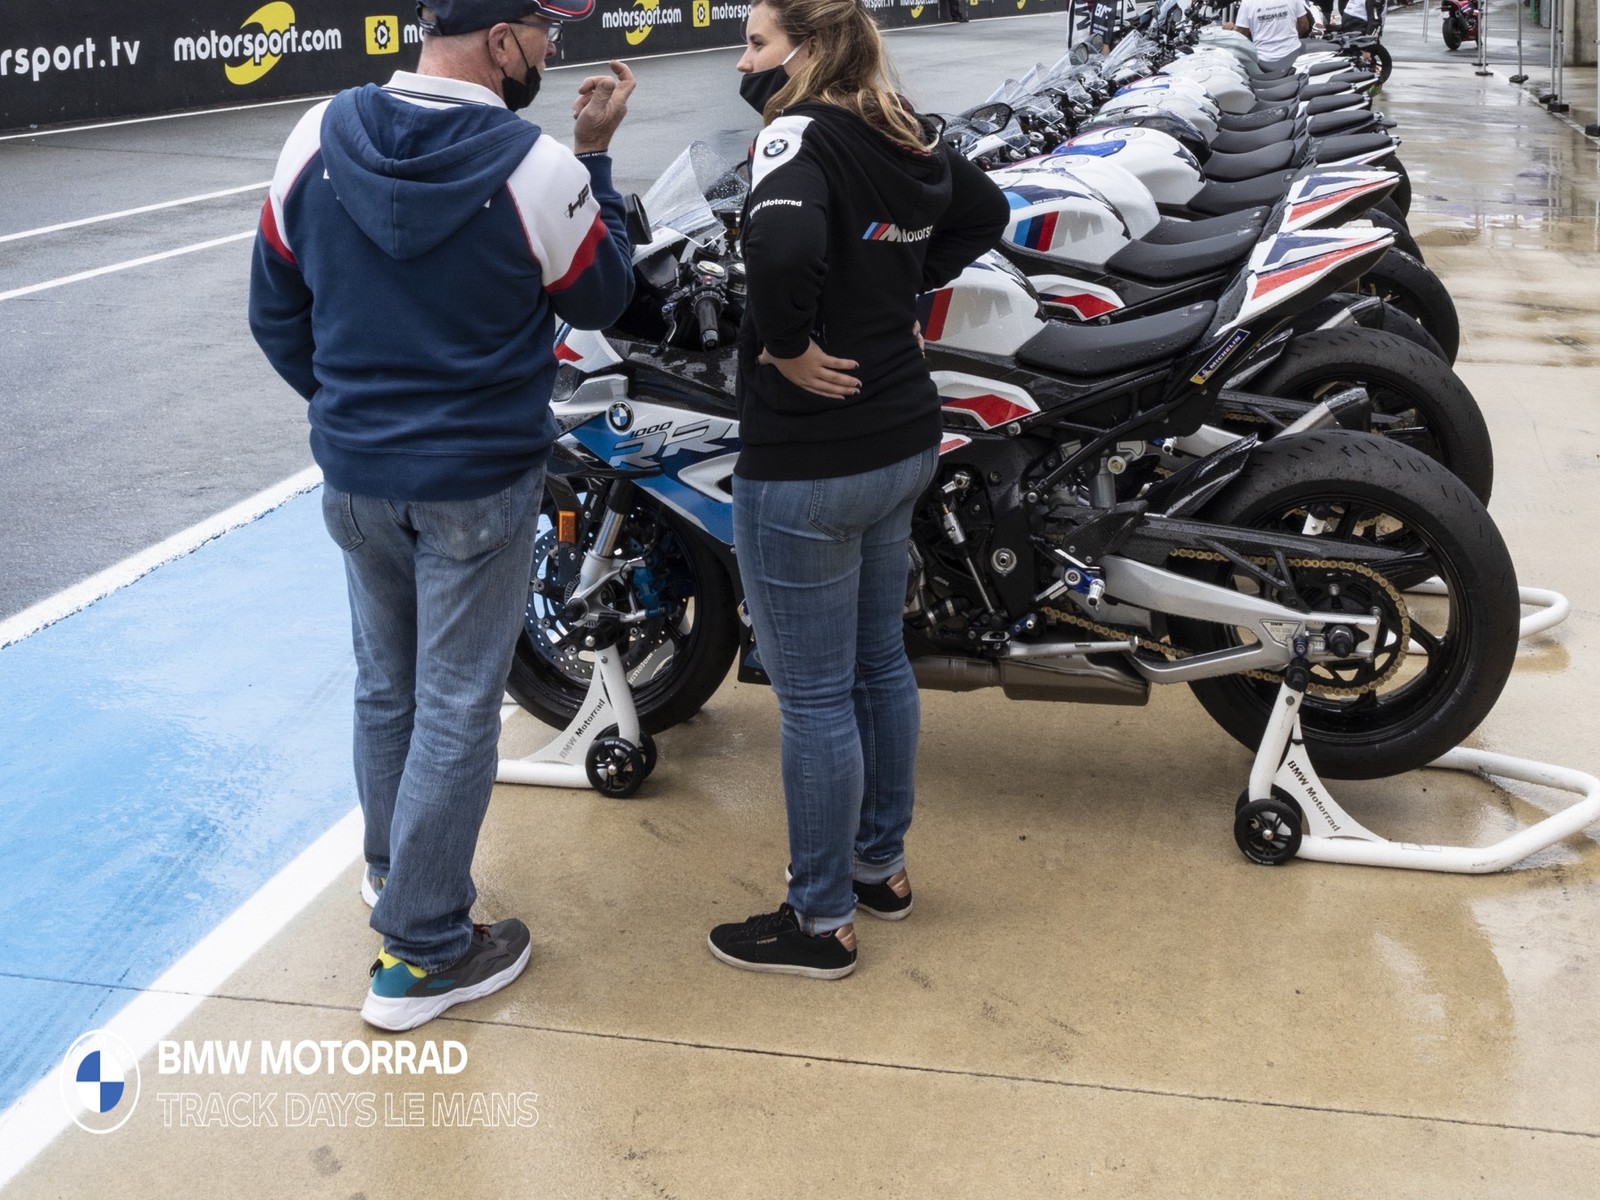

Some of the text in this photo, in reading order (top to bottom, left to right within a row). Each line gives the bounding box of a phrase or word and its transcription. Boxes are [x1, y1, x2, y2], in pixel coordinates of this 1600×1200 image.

[602, 5, 682, 31] motorsport.com
[0, 35, 141, 82] rsport.tv
[173, 25, 342, 63] motorsport.com
[761, 198, 803, 208] Motorrad
[1209, 335, 1242, 370] MICHELIN
[630, 421, 674, 438] 1000
[559, 698, 606, 759] BMW Motorrad
[1287, 759, 1341, 833] BMW Motorrad
